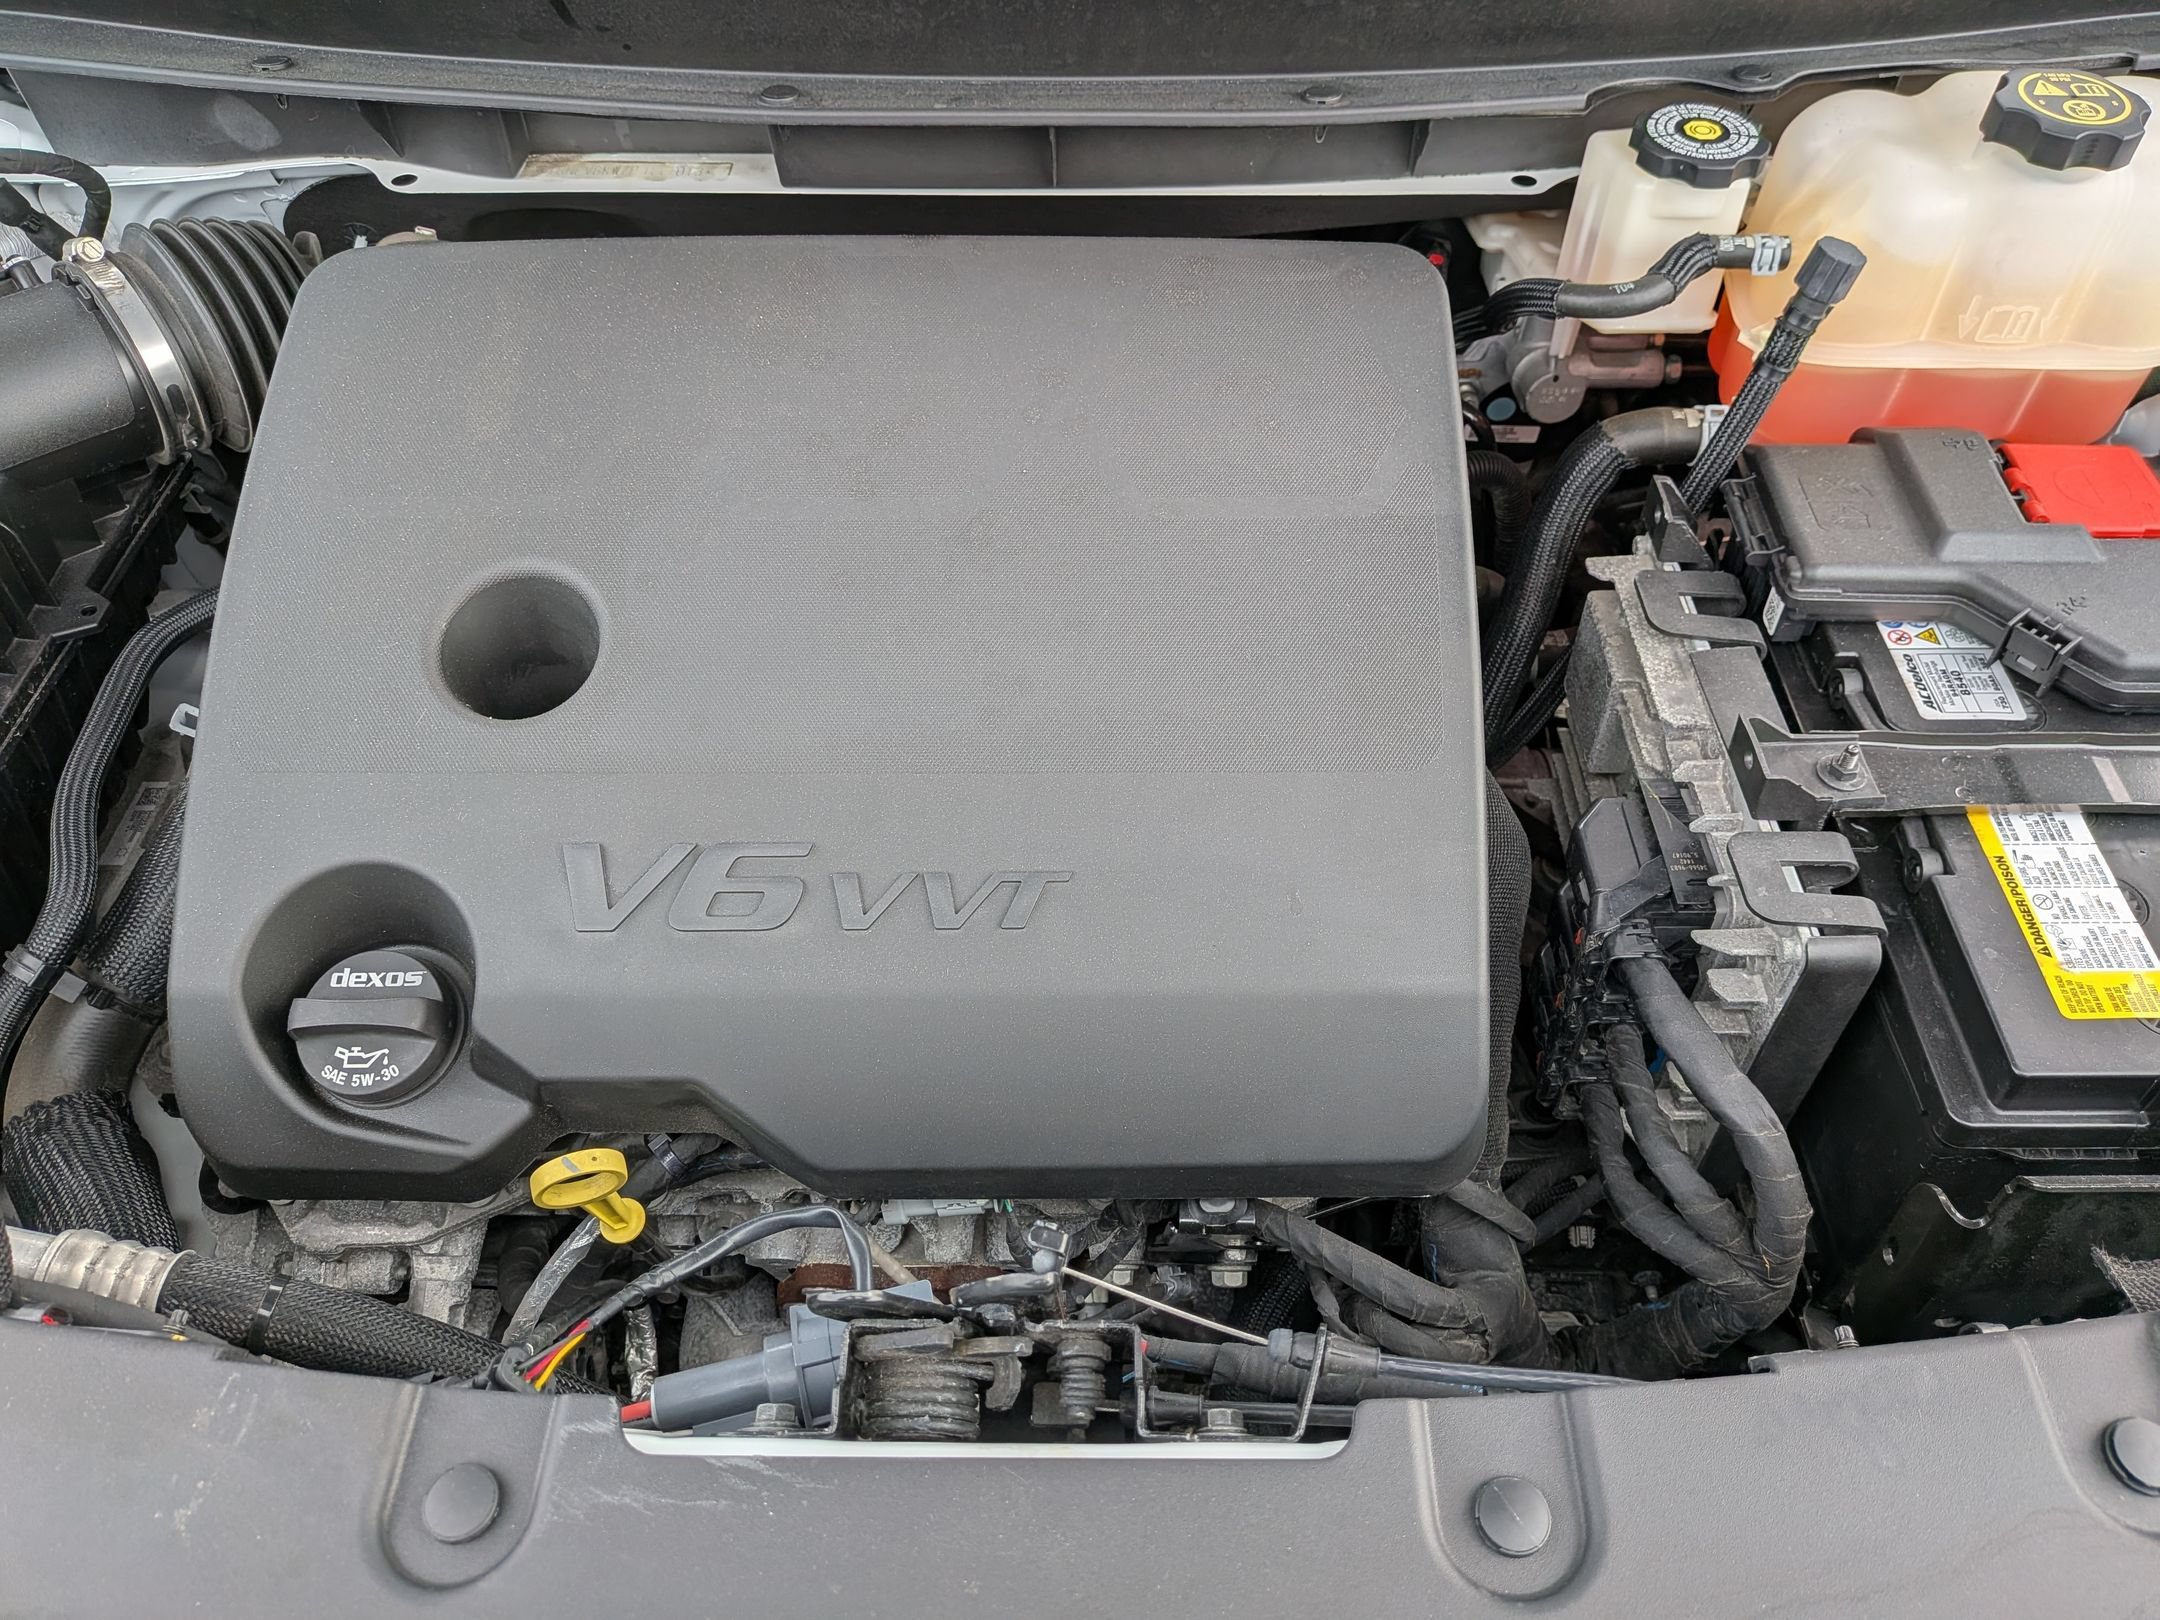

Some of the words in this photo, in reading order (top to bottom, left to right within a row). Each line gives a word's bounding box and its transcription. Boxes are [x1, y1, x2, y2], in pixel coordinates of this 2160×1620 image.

[1902, 654, 1938, 711] ACDelco
[1950, 670, 1971, 695] 8540
[1997, 696, 2009, 708] 730
[562, 841, 815, 934] V6
[832, 871, 1074, 931] VVT
[1994, 855, 2046, 944] DANGER/POISON
[330, 968, 424, 988] dexos
[321, 1064, 348, 1085] SAE
[351, 1064, 400, 1087] 5W-30
